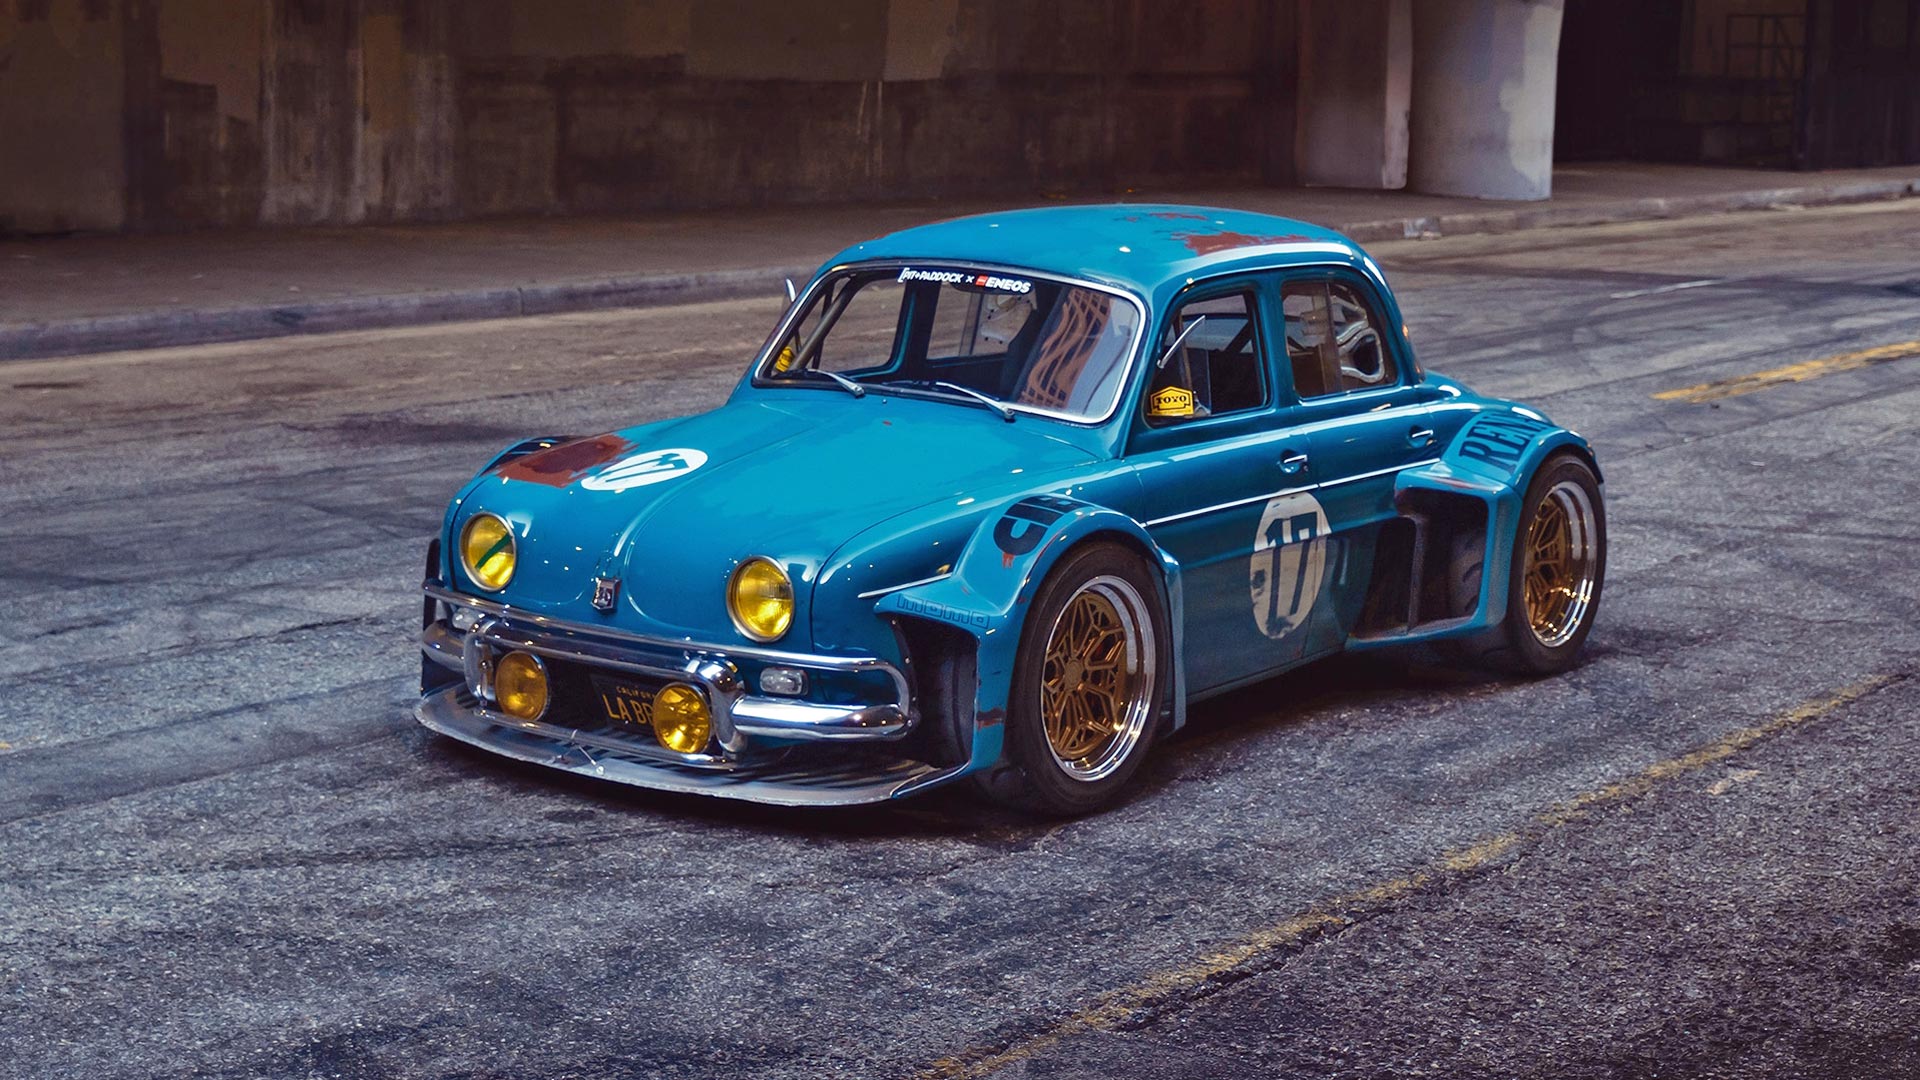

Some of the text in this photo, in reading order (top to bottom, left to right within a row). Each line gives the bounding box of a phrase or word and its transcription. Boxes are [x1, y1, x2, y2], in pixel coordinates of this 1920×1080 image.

[985, 276, 1032, 294] ENEOS
[1156, 395, 1187, 404] TOYO
[1264, 511, 1318, 633] 17
